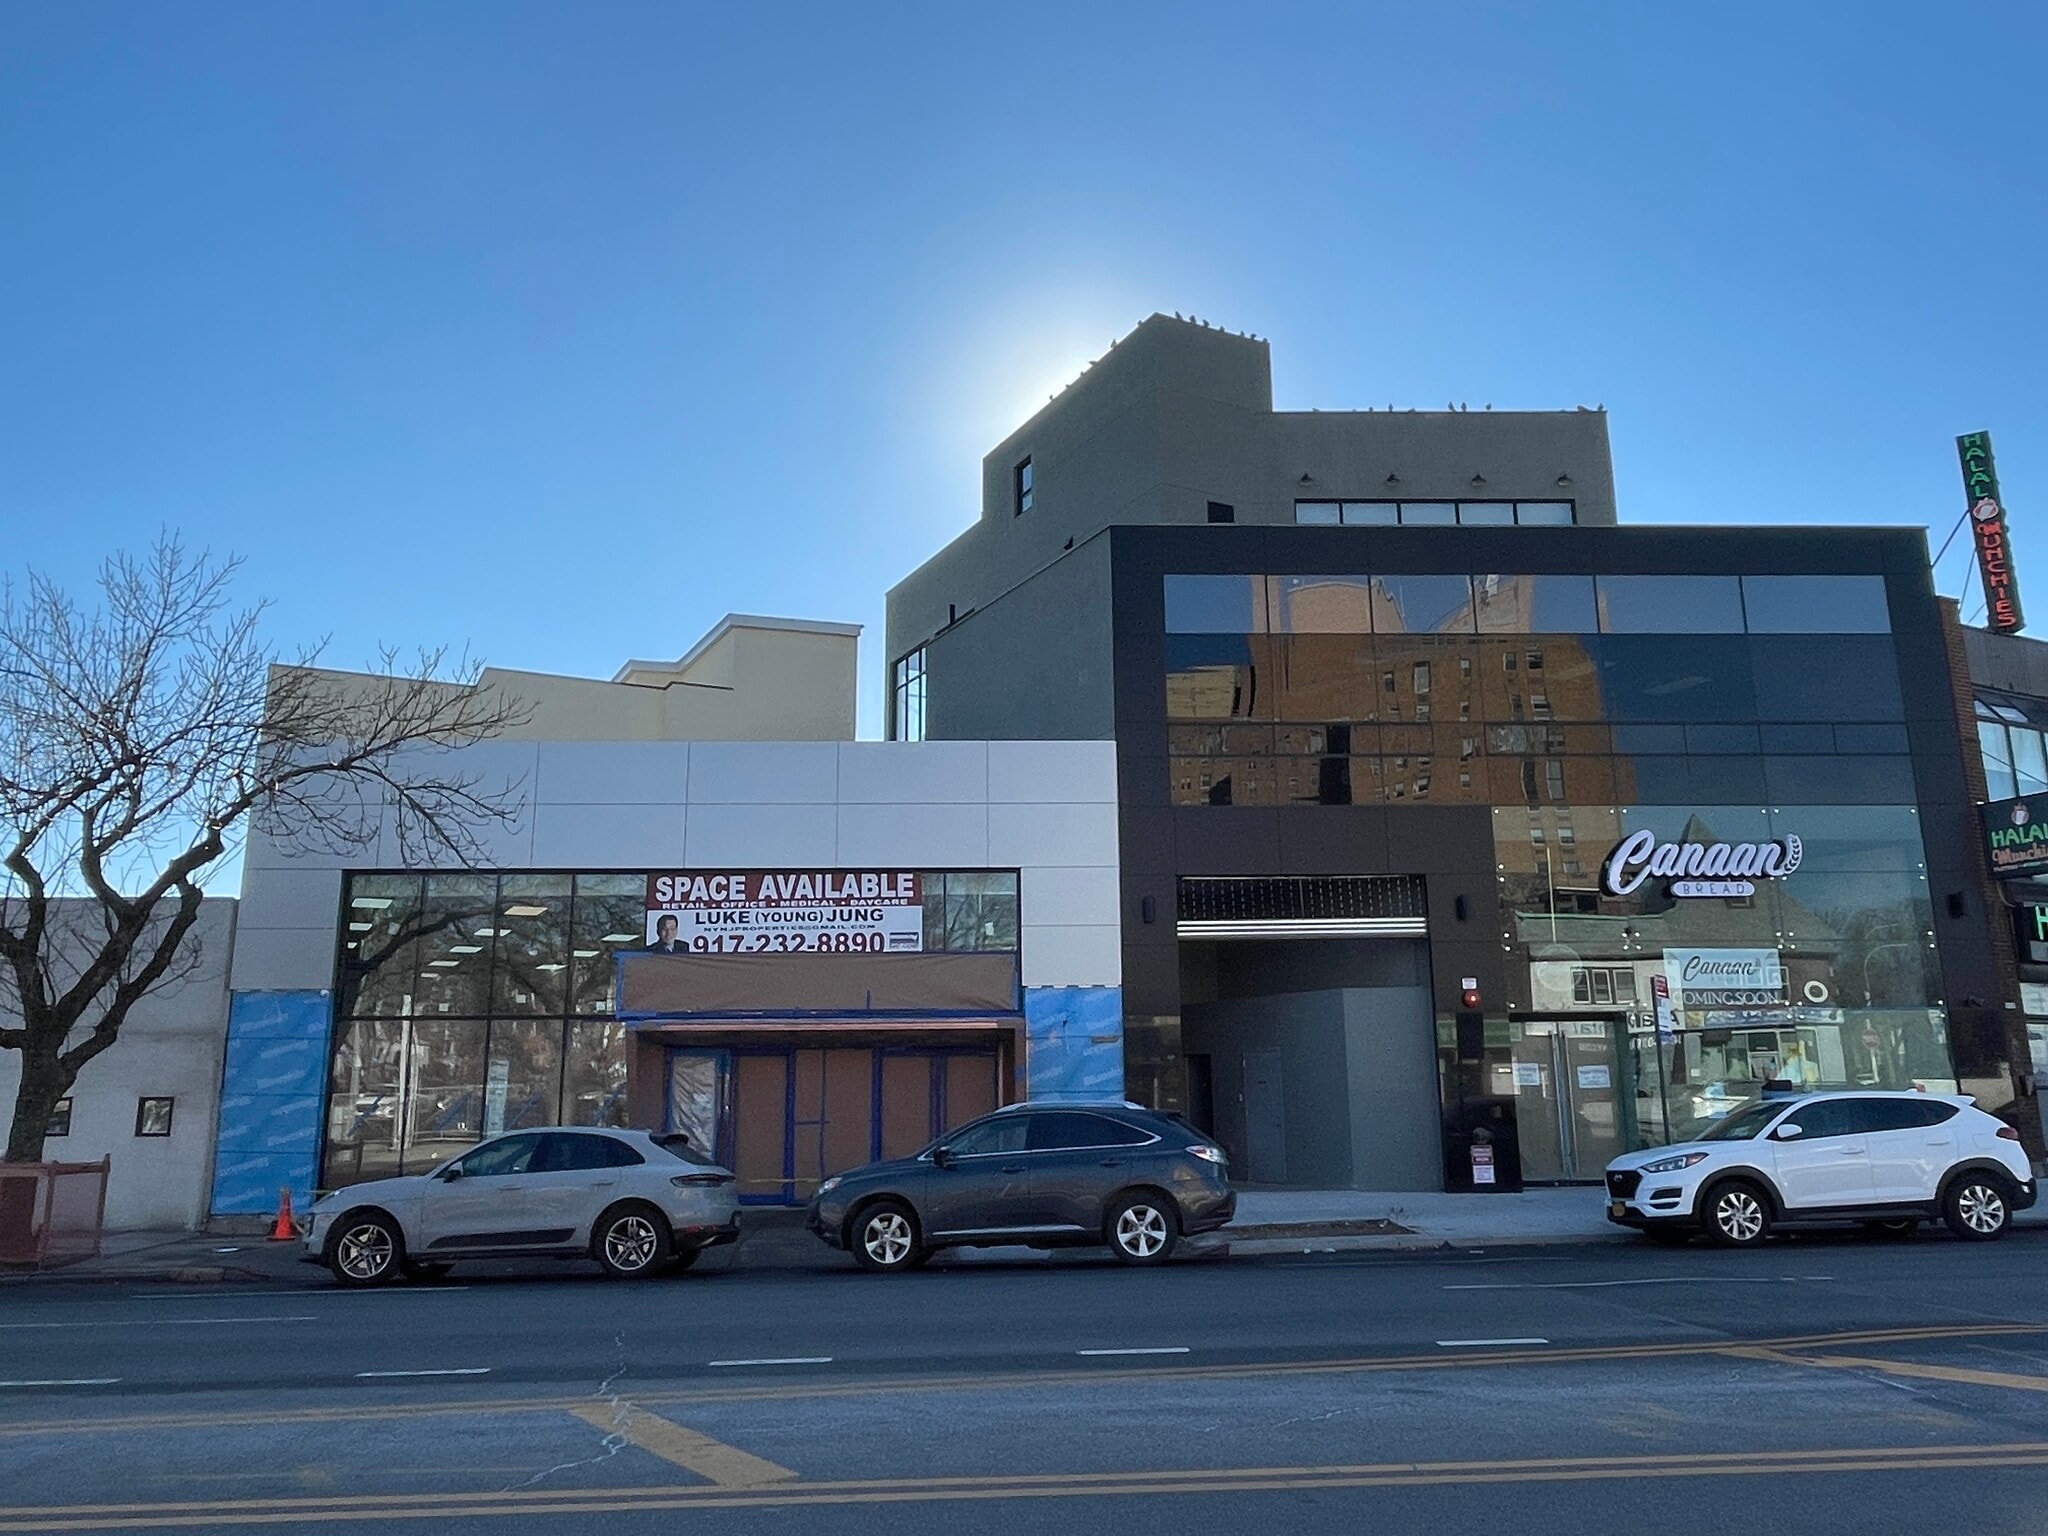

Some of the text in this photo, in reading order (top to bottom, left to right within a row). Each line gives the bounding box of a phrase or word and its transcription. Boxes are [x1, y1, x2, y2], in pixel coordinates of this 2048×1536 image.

[1963, 433, 2017, 627] HALAL MUNCHIES
[1606, 829, 1787, 895] Canaan
[655, 873, 914, 902] SPACE AVAILABLE
[1682, 882, 1746, 895] BREAD
[662, 898, 908, 910] RETAIL OFFICE MEDICAL DAYCARE
[694, 908, 885, 925] LUKE (YOUNG) JUNG
[693, 932, 885, 953] 917-232-8890
[1682, 955, 1756, 982] Canaan
